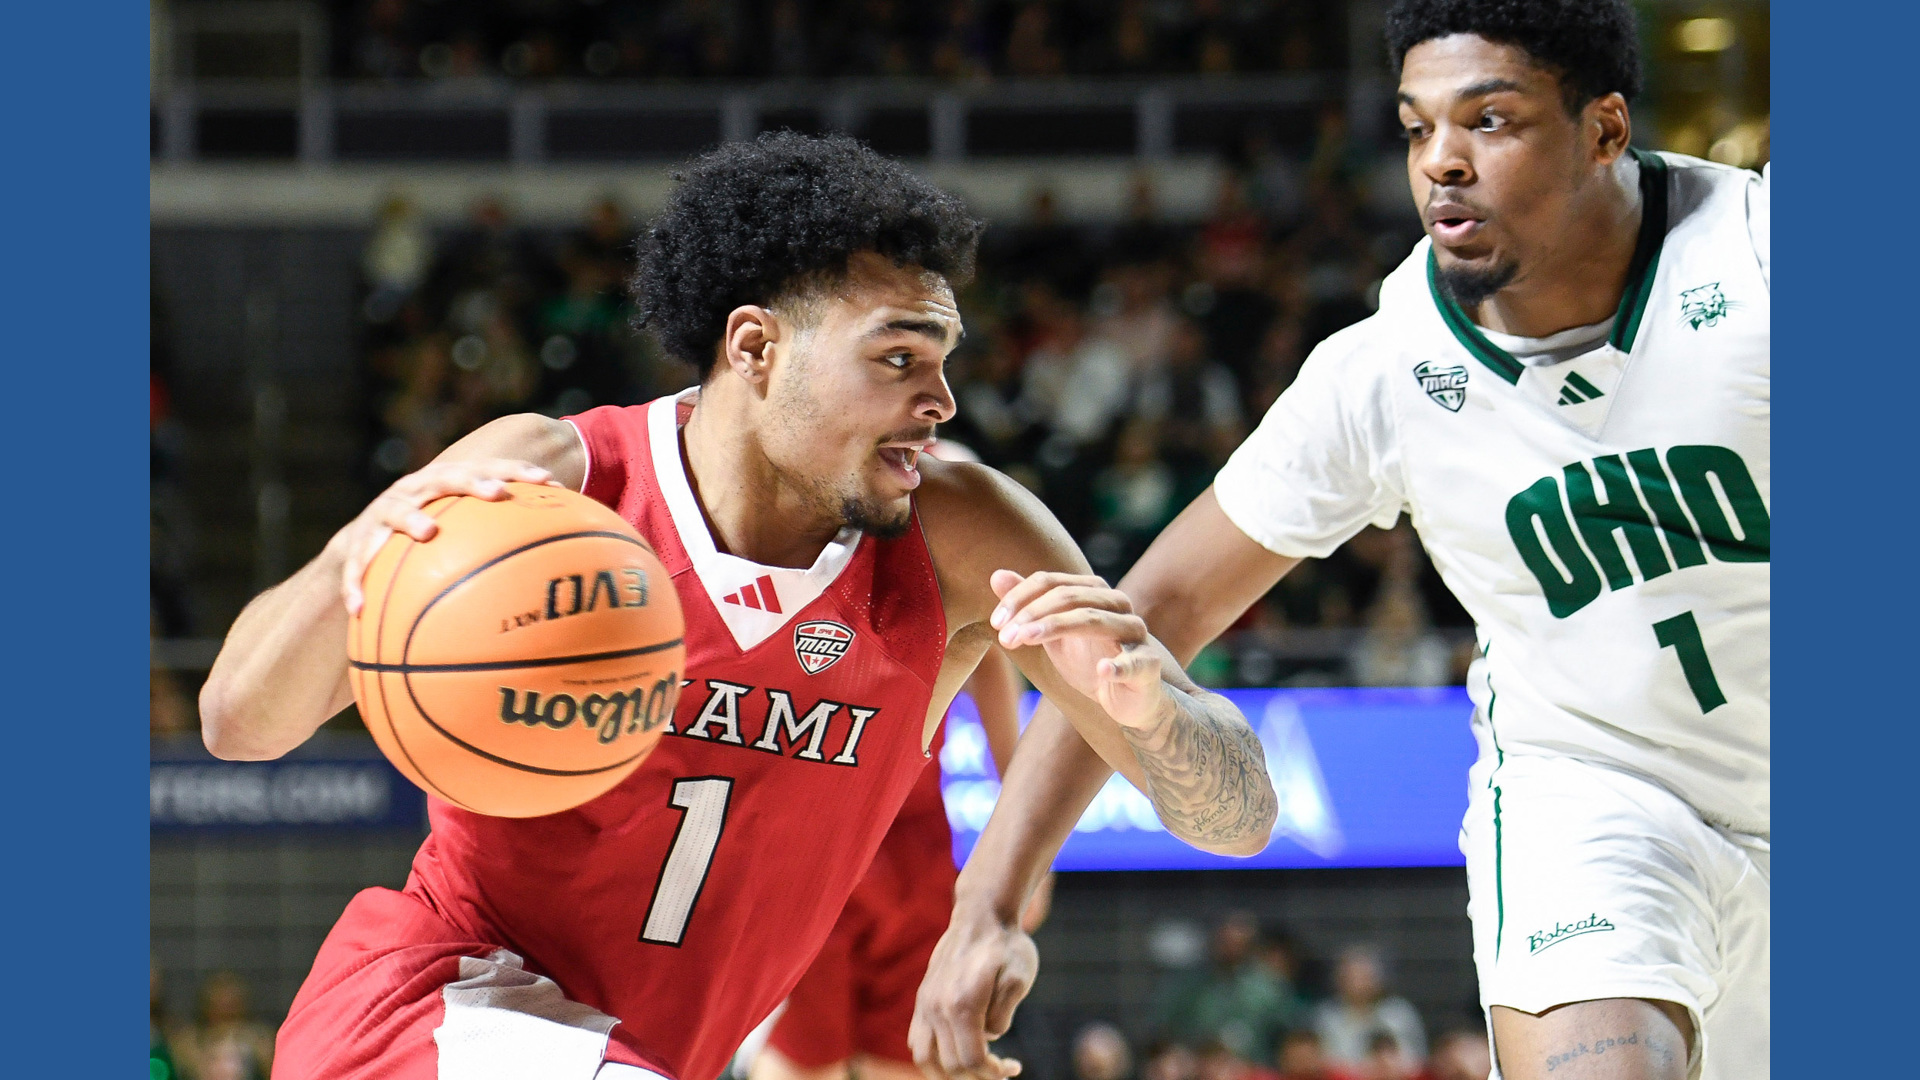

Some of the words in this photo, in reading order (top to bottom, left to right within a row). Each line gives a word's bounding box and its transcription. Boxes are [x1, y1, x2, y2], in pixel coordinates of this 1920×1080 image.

[1420, 374, 1468, 392] MAC
[1506, 445, 1770, 619] OHIO
[546, 568, 649, 620] EVO
[796, 637, 847, 656] MAC
[1652, 610, 1728, 715] 1
[497, 671, 678, 744] Wilson
[662, 678, 881, 767] AMI
[638, 775, 735, 948] 1
[1526, 913, 1615, 953] Bobcats
[1594, 1032, 1638, 1055] good
